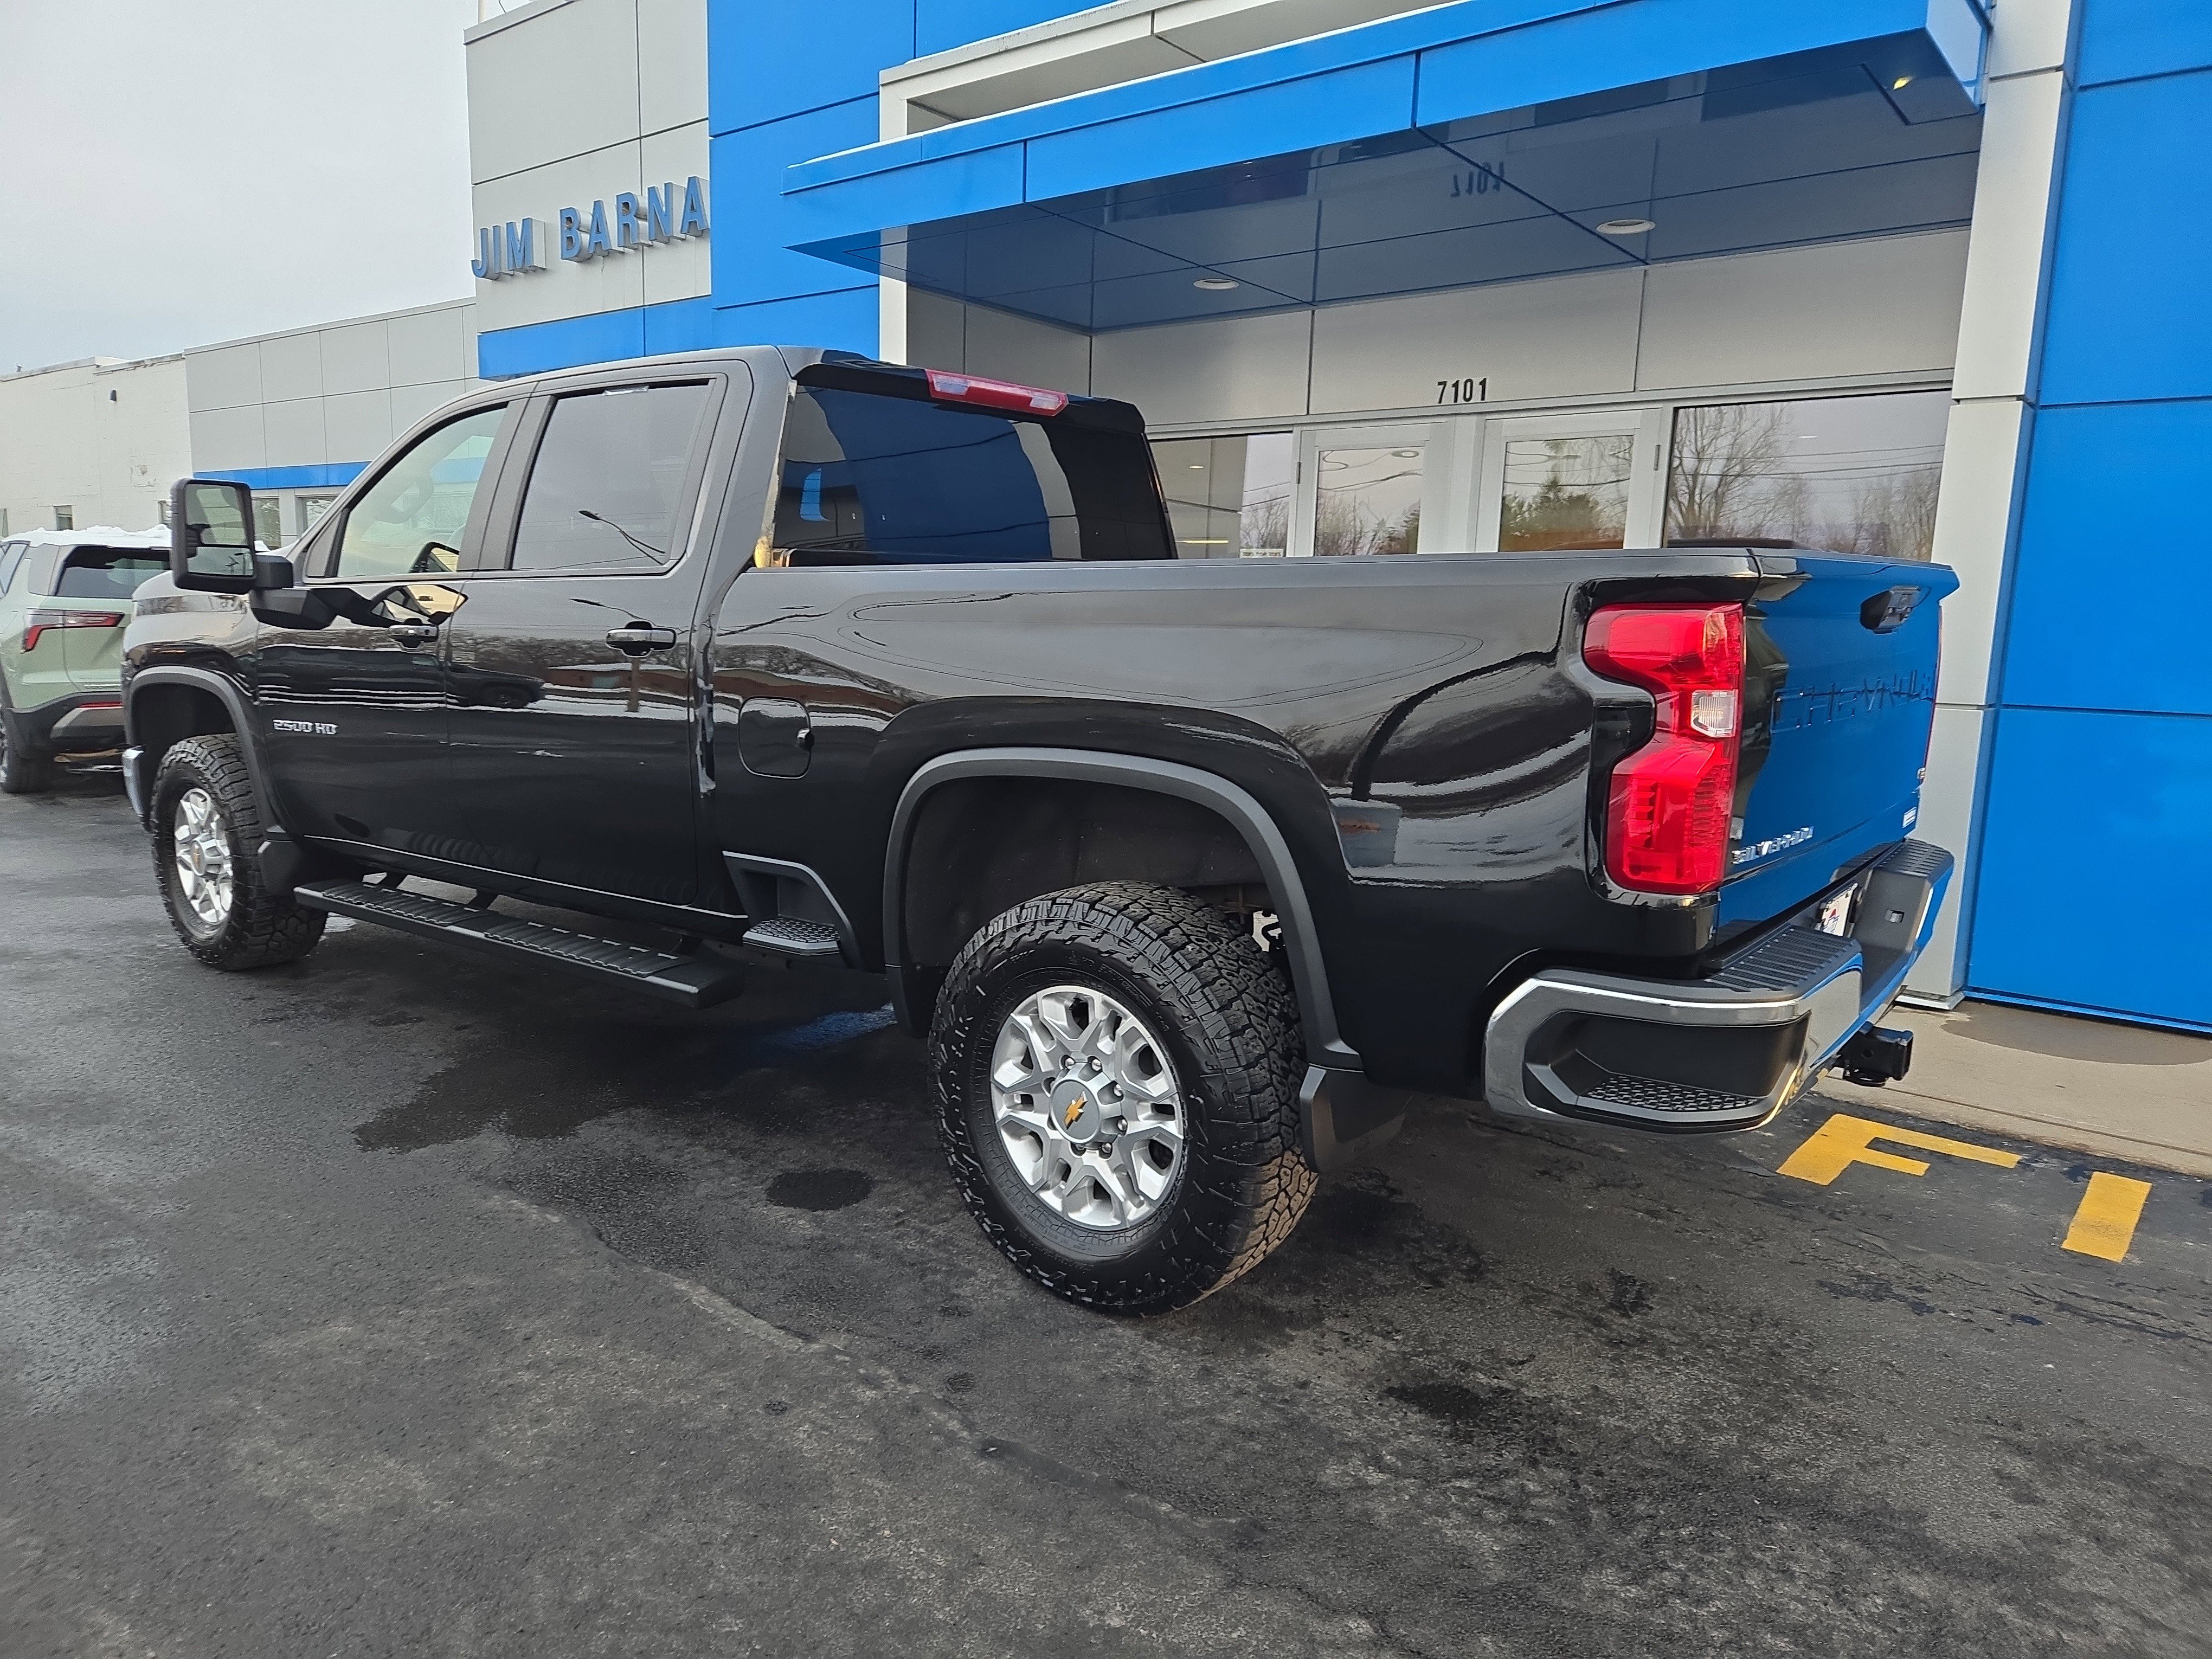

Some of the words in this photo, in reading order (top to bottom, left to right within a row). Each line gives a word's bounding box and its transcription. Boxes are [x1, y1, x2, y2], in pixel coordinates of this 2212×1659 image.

[471, 217, 543, 279] JIM
[559, 176, 710, 262] BARNA
[1437, 377, 1487, 404] 7101
[272, 719, 314, 732] 2500
[314, 722, 338, 735] HD
